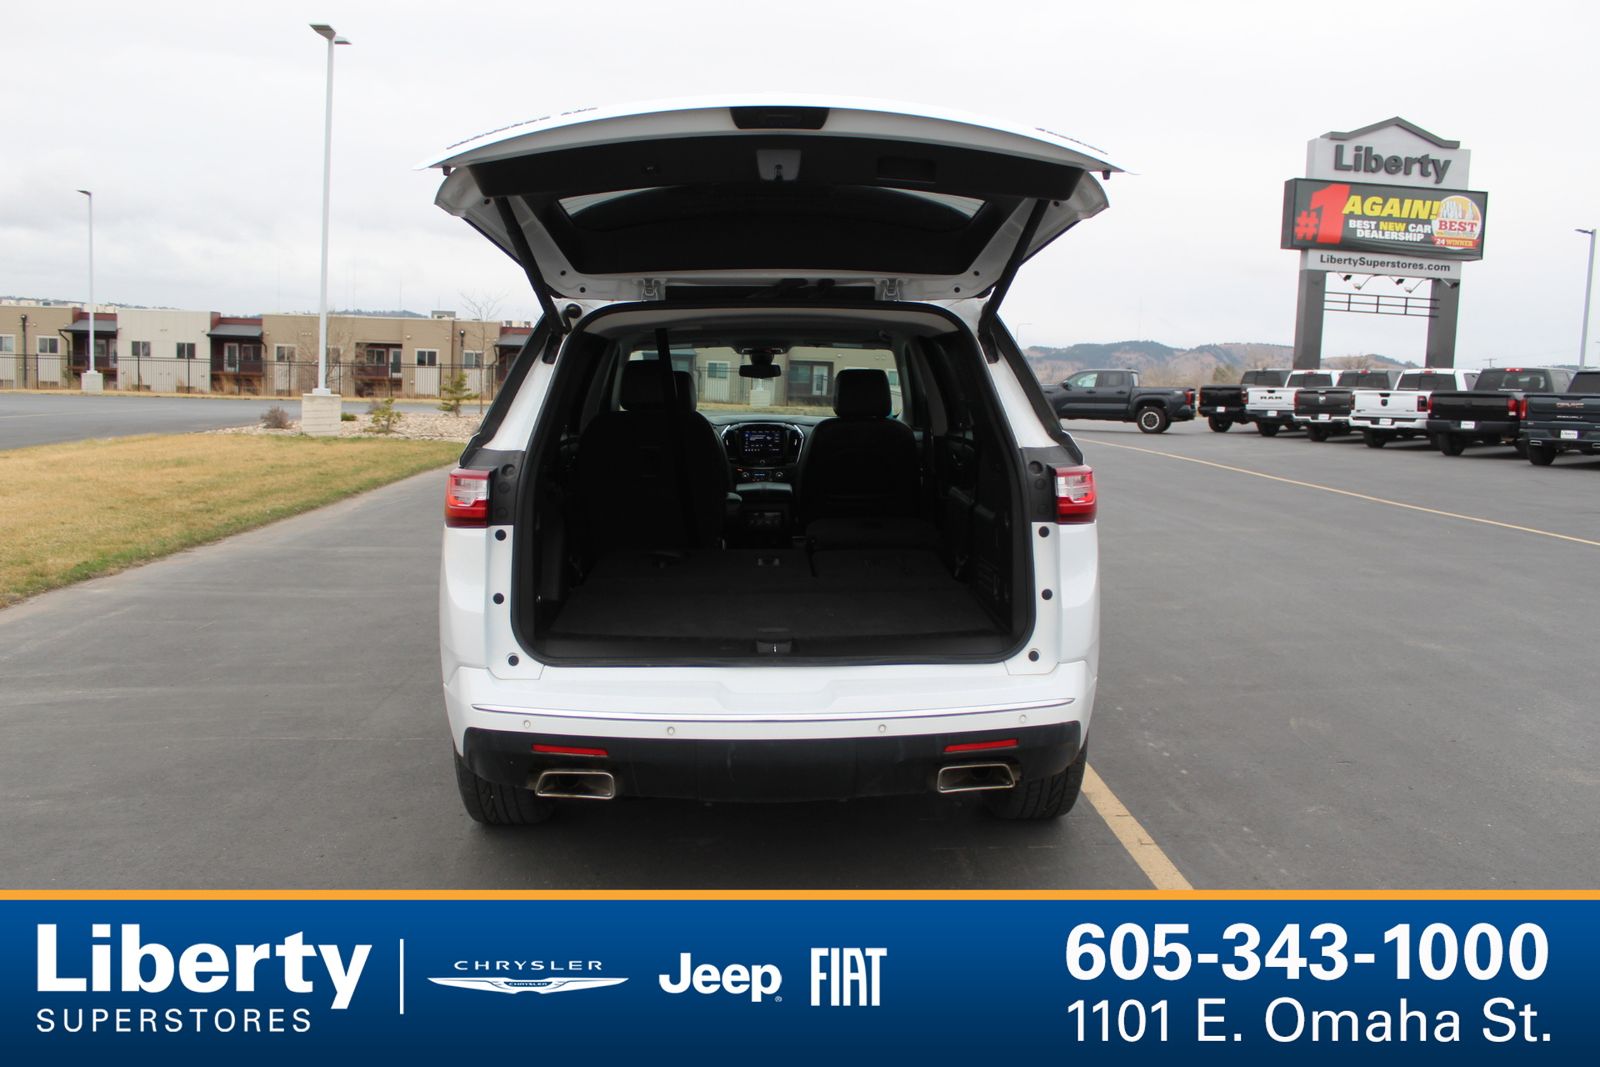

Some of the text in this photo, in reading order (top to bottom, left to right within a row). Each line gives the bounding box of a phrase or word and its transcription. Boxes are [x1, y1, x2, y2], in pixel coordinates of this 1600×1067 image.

[1334, 144, 1452, 184] Liberty
[1295, 183, 1441, 244] #1 AGAIN!
[1349, 219, 1431, 234] BEST NEW CAR
[1438, 220, 1477, 232] BEST
[1356, 229, 1424, 242] DEALERSHIP
[1320, 254, 1450, 272] LibertySuperstores.com
